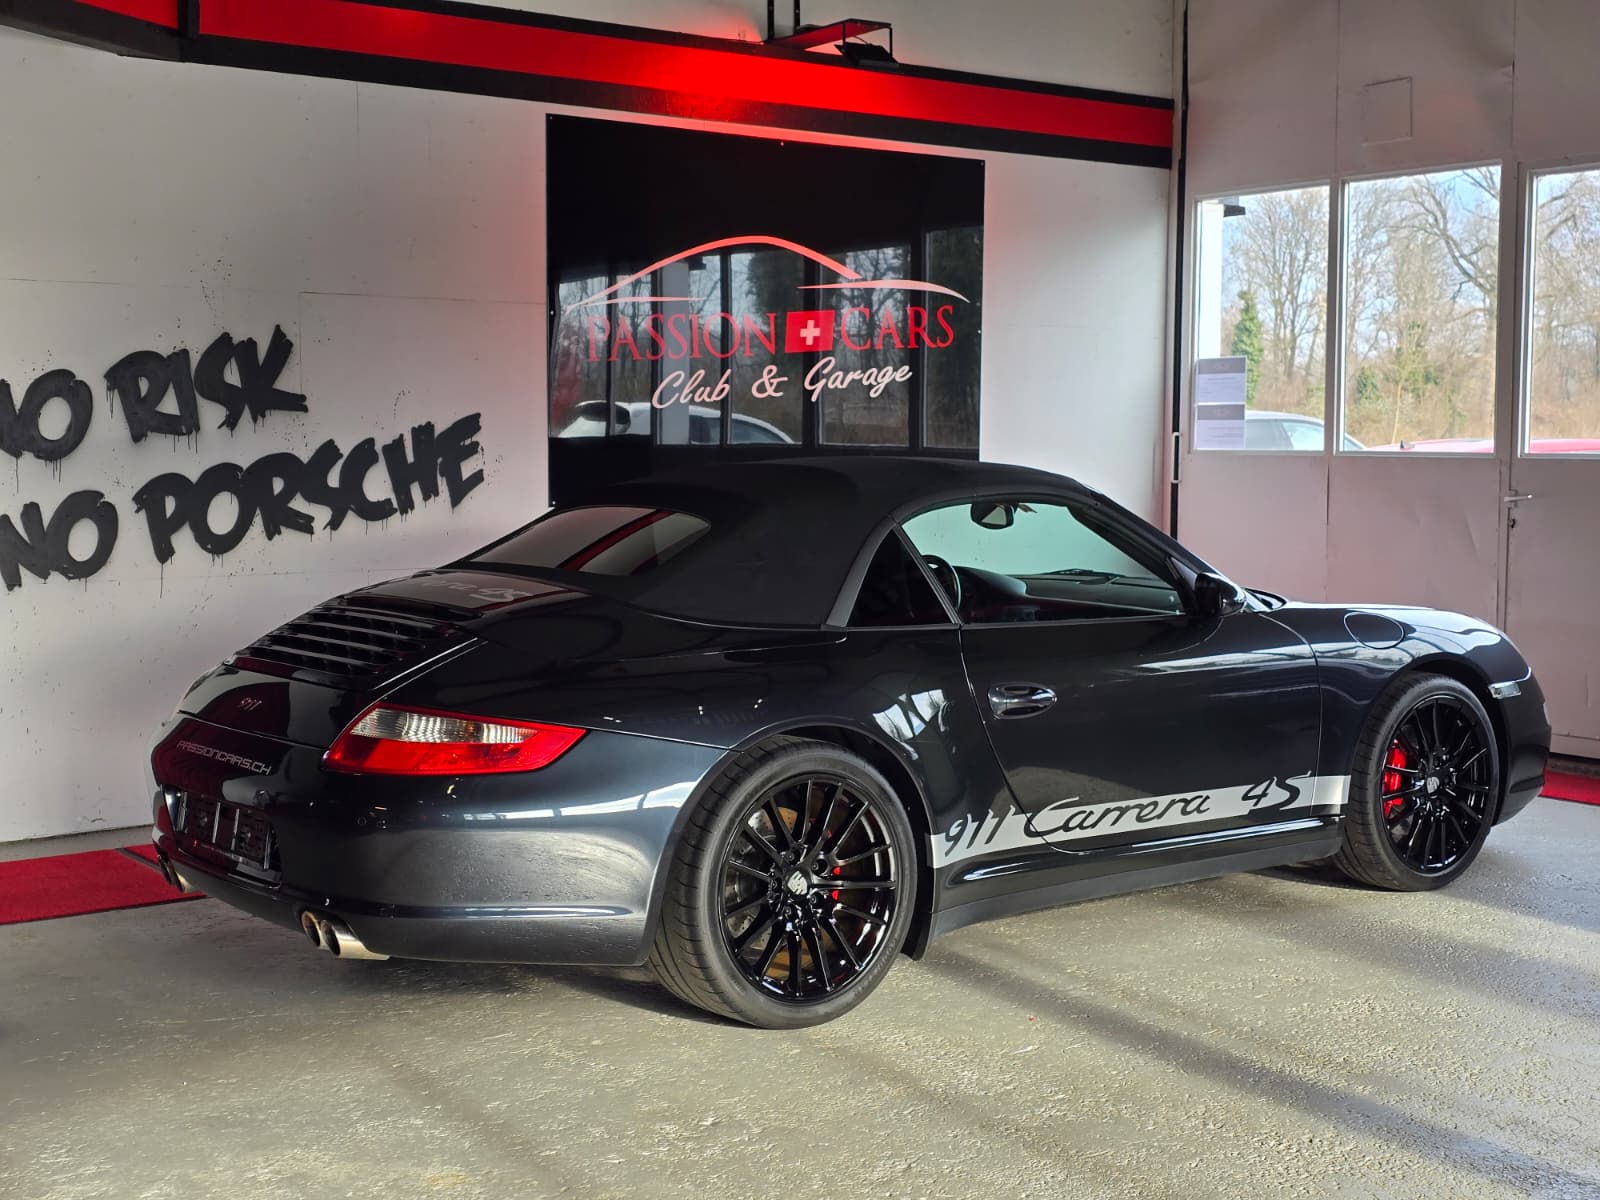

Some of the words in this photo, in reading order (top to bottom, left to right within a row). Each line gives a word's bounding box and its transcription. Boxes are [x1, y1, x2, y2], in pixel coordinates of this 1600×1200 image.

[586, 311, 777, 363] PASSION
[839, 305, 955, 351] CARS
[103, 324, 308, 443] RISK
[651, 364, 731, 409] Club
[751, 364, 789, 400] &
[804, 356, 913, 402] Garage
[0, 489, 119, 591] NO
[132, 412, 485, 565] PORSCHE
[944, 804, 1016, 857] 911
[1023, 796, 1211, 837] Carrera
[1241, 770, 1312, 811] 4S
